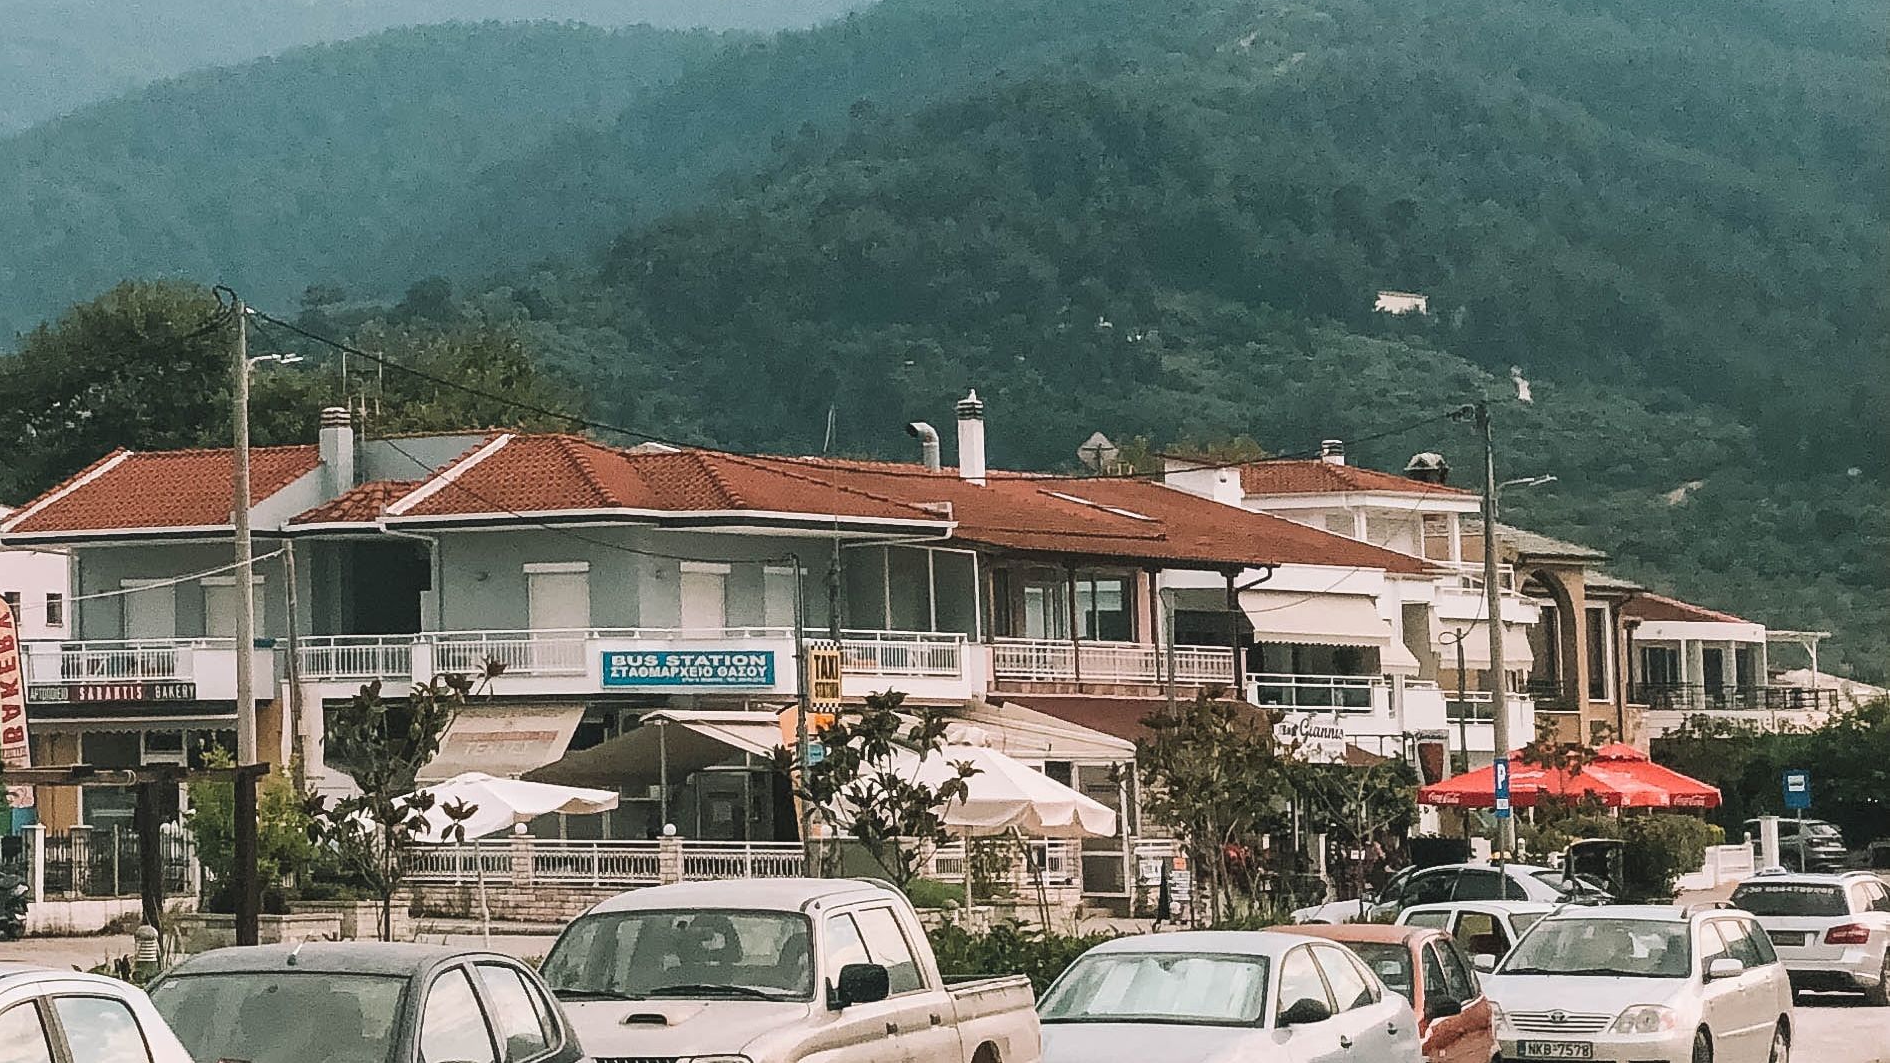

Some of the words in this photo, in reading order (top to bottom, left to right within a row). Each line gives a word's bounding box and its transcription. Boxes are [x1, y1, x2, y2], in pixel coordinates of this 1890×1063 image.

[611, 655, 659, 667] BUS
[665, 654, 767, 667] STATION
[814, 655, 839, 680] TAXI
[154, 684, 196, 699] BAKERY
[1528, 1042, 1590, 1057] NKB-7578
